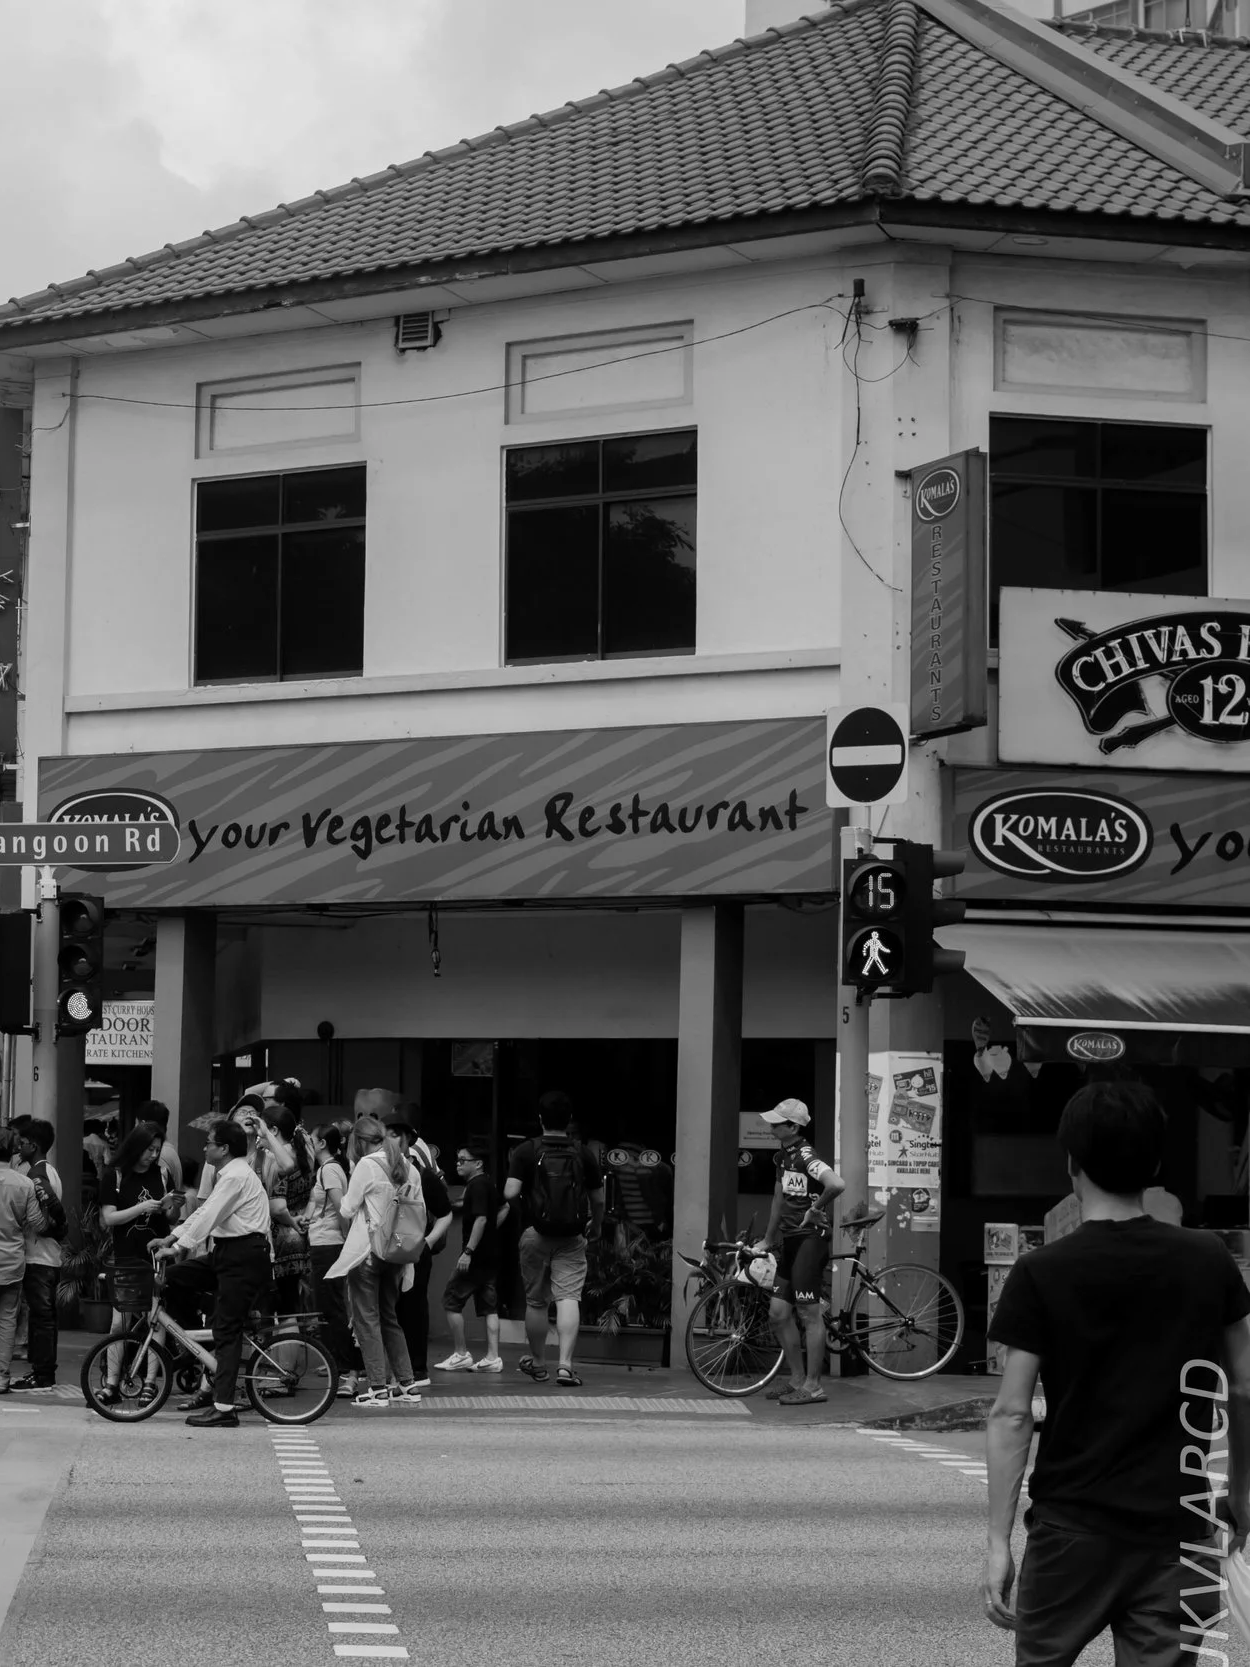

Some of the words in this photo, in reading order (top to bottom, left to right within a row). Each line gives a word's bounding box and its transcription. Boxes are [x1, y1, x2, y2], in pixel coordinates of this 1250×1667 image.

[930, 524, 944, 722] RESTAURANTS
[1071, 621, 1223, 692] CHIVAS
[1199, 673, 1250, 726] 12
[125, 827, 161, 853] Rd
[188, 818, 290, 863] your
[302, 801, 526, 860] Vegetarian
[545, 788, 809, 841] Restaurant
[993, 811, 1129, 847] KOMALA'S
[1037, 844, 1126, 860] RESTAURANTS
[868, 872, 894, 909] 15
[101, 1017, 152, 1033] DOOR
[842, 1005, 850, 1024] 5
[86, 1049, 108, 1058] RATE
[33, 1065, 40, 1082] 6
